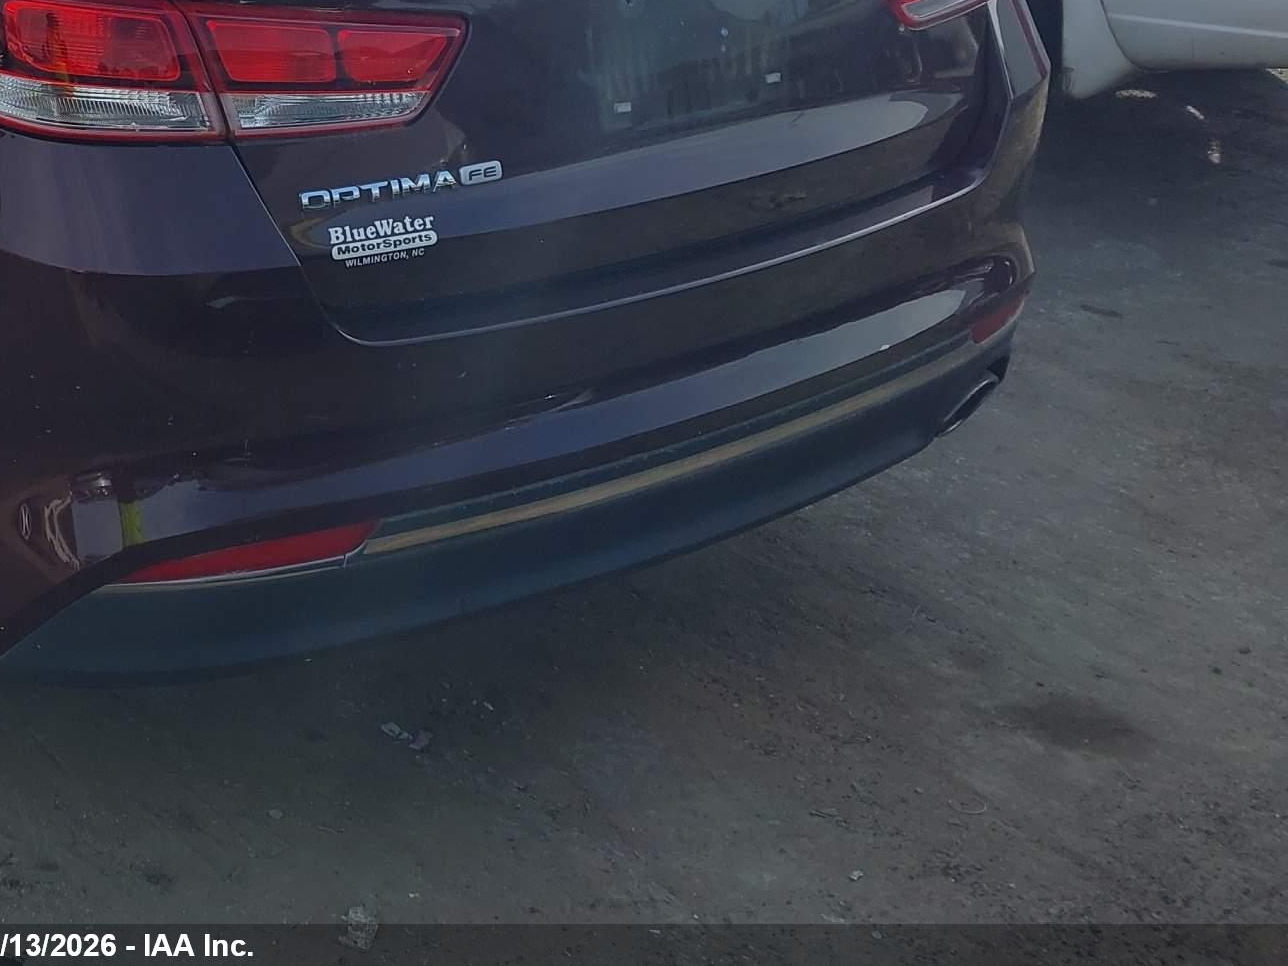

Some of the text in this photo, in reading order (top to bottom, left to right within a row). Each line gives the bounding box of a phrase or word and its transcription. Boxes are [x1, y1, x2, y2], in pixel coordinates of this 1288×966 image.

[299, 165, 497, 210] OPTIMA FE
[328, 215, 435, 245] BlueWater
[336, 233, 433, 256] MotorSports
[344, 247, 425, 268] WILMINGTON, NC
